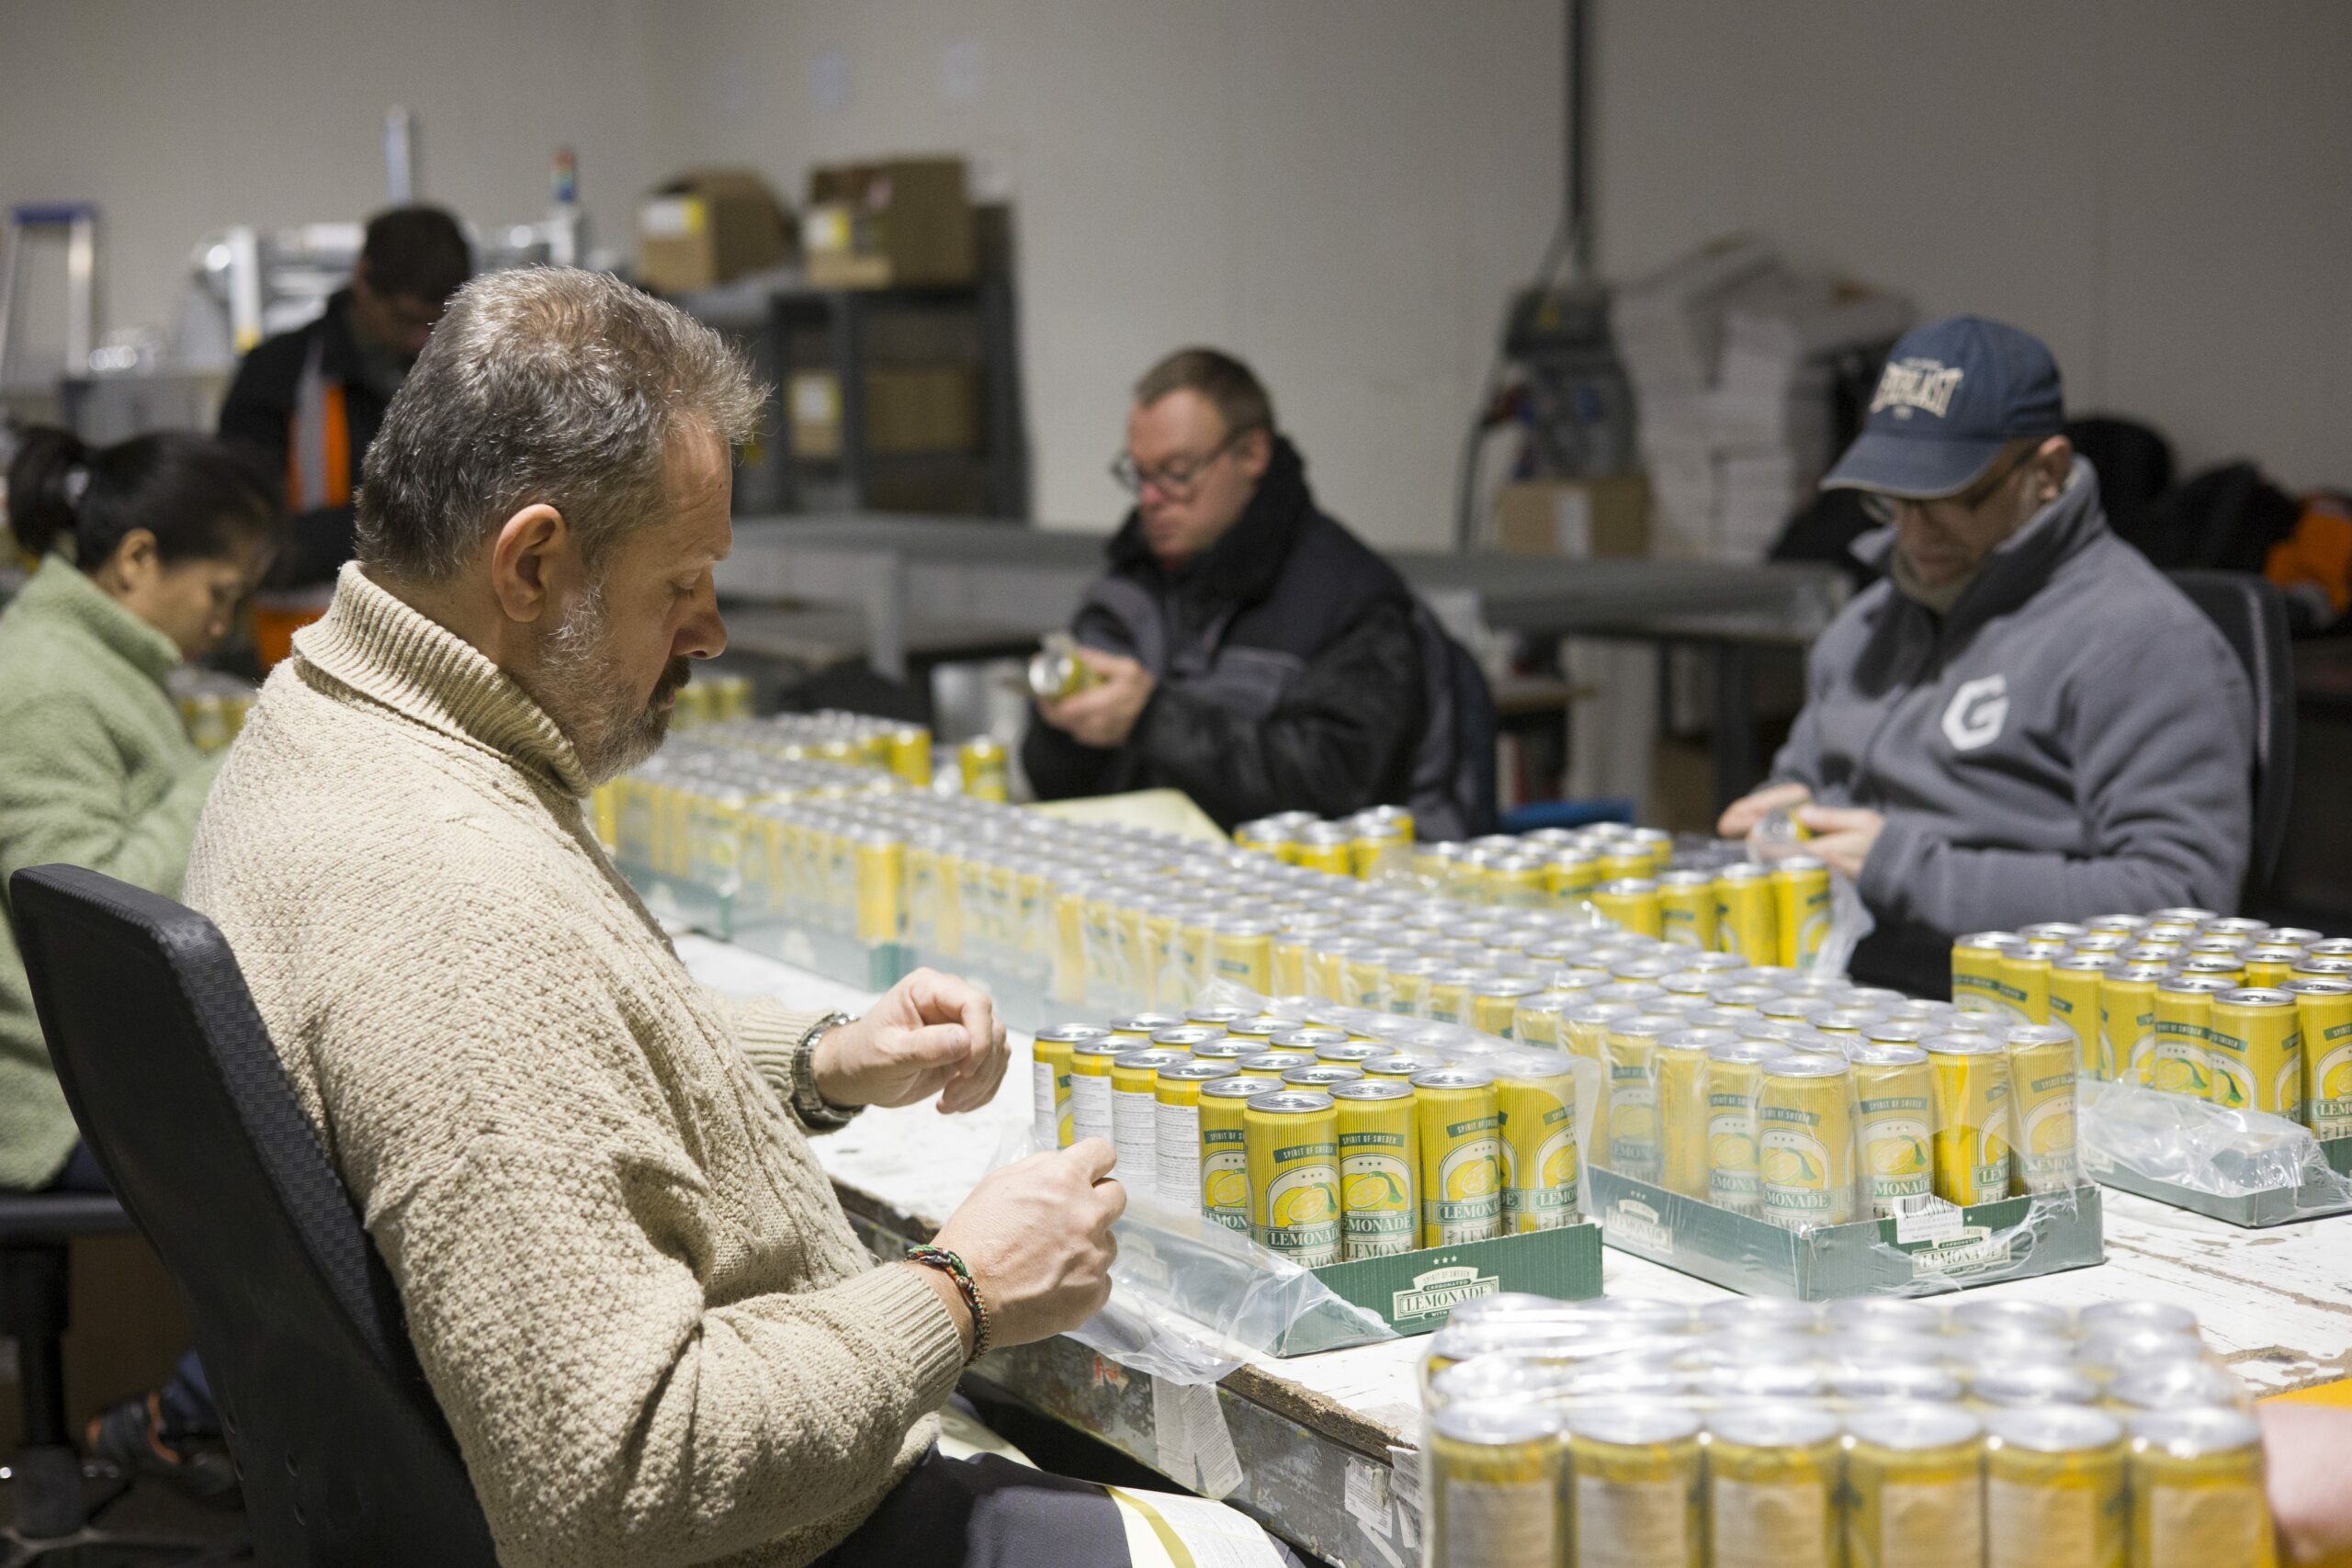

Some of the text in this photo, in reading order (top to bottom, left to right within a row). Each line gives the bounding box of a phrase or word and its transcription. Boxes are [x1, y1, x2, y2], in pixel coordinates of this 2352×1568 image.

[1942, 673, 2009, 750] G
[1283, 1147, 1304, 1159] SPIRIT
[1342, 1215, 1411, 1233] EMONADE
[1941, 1237, 1981, 1248] CARBONATED
[1426, 1279, 1469, 1291] CARBONATED
